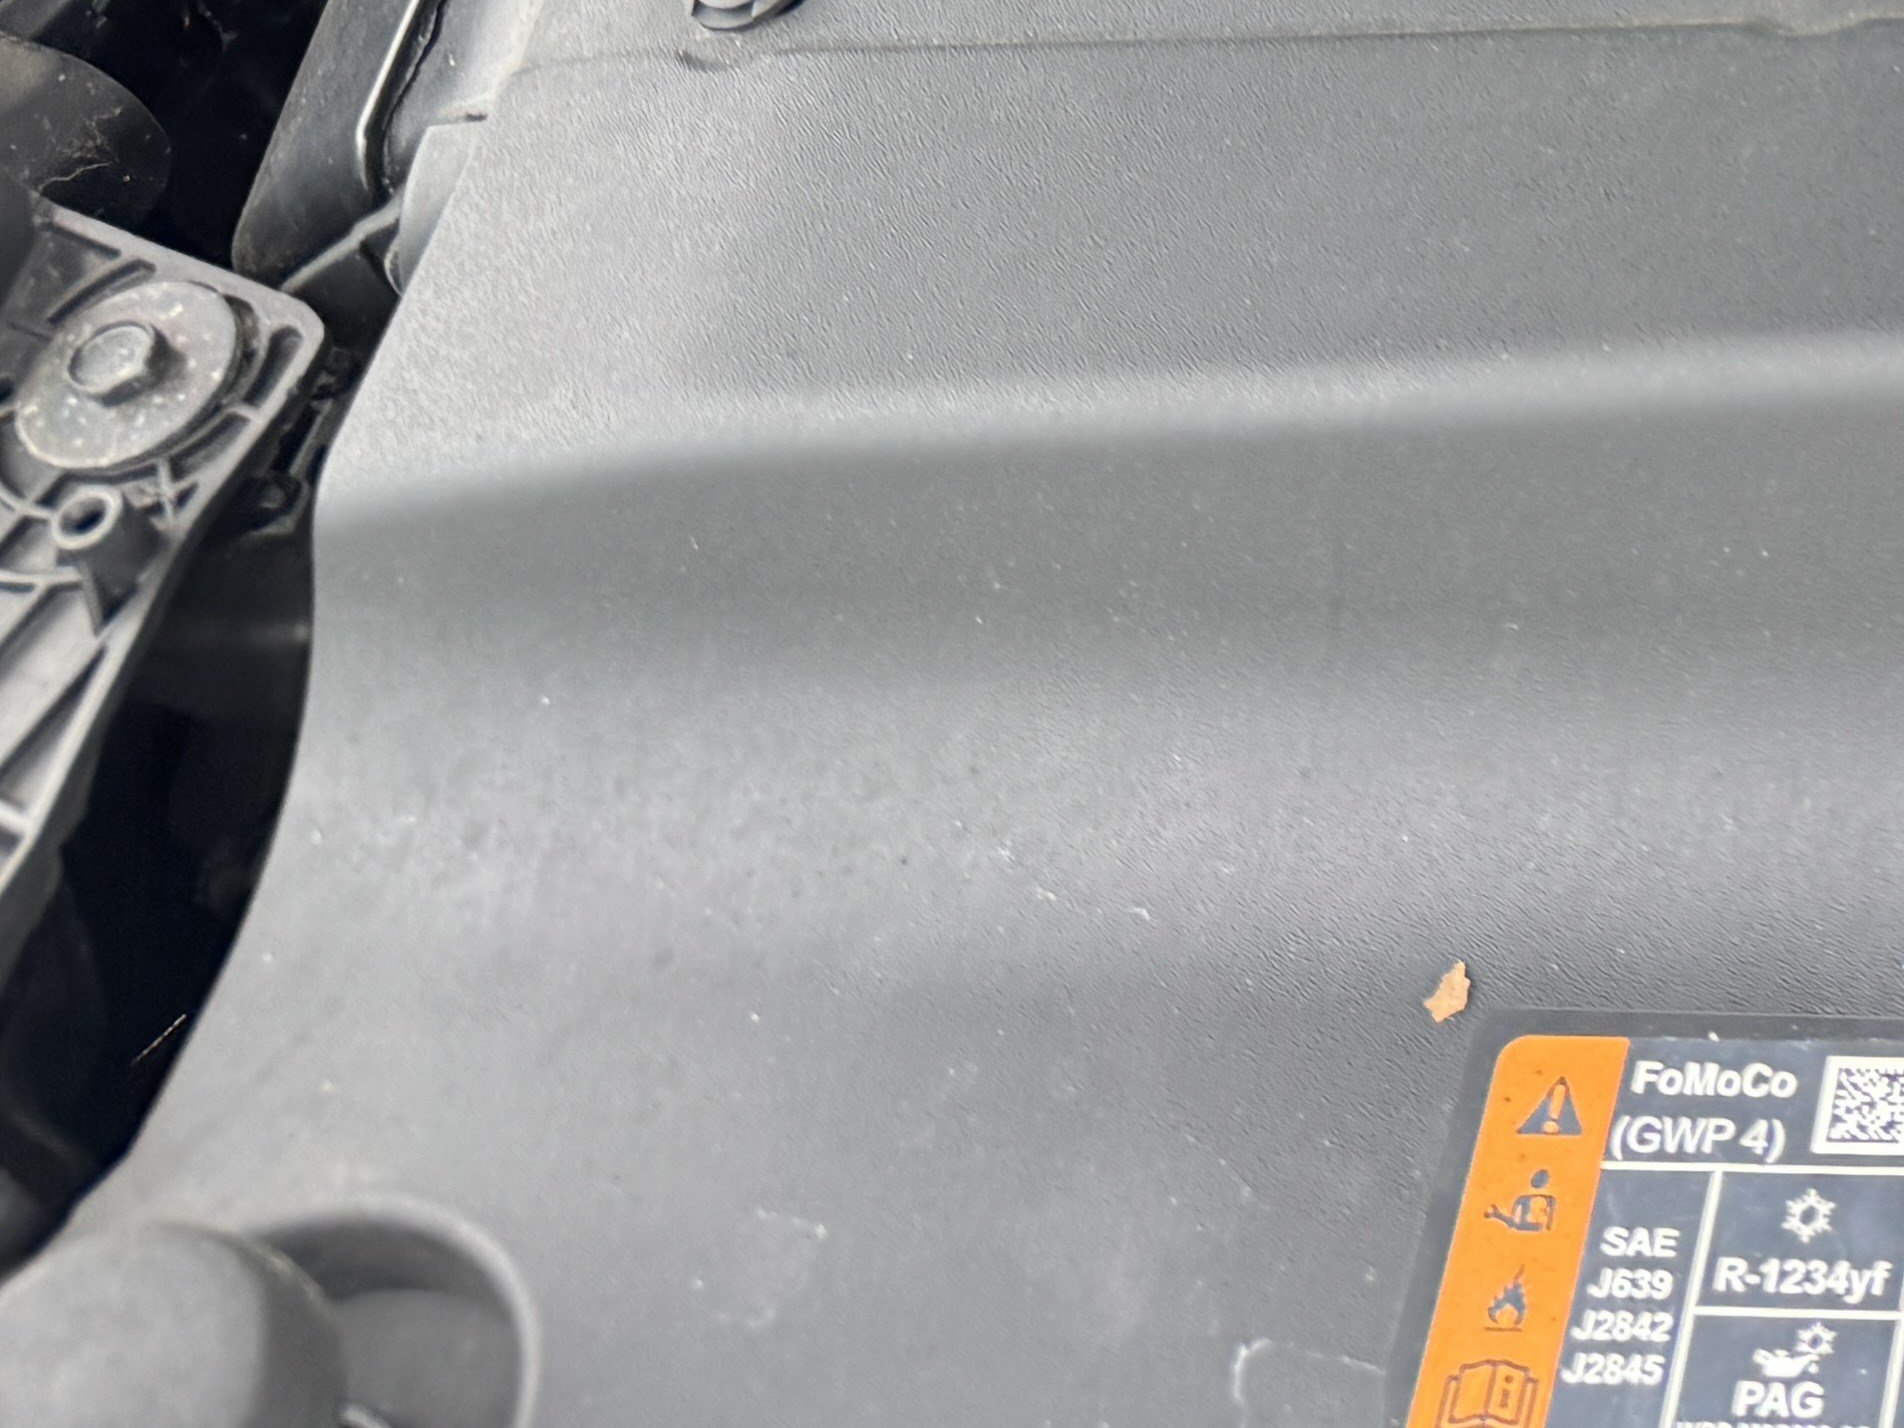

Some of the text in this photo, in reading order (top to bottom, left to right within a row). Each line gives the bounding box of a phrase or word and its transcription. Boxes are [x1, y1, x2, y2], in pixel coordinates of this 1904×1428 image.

[1630, 1060, 1798, 1099] FoMoCo
[1611, 1115, 1786, 1165] (GWP 4)
[1599, 1226, 1681, 1258] SAE
[1586, 1269, 1673, 1300] J639
[1712, 1257, 1893, 1304] R-1234yf
[1569, 1310, 1674, 1343] J2842
[1560, 1353, 1666, 1386] J2845
[1730, 1380, 1826, 1418] PAG
